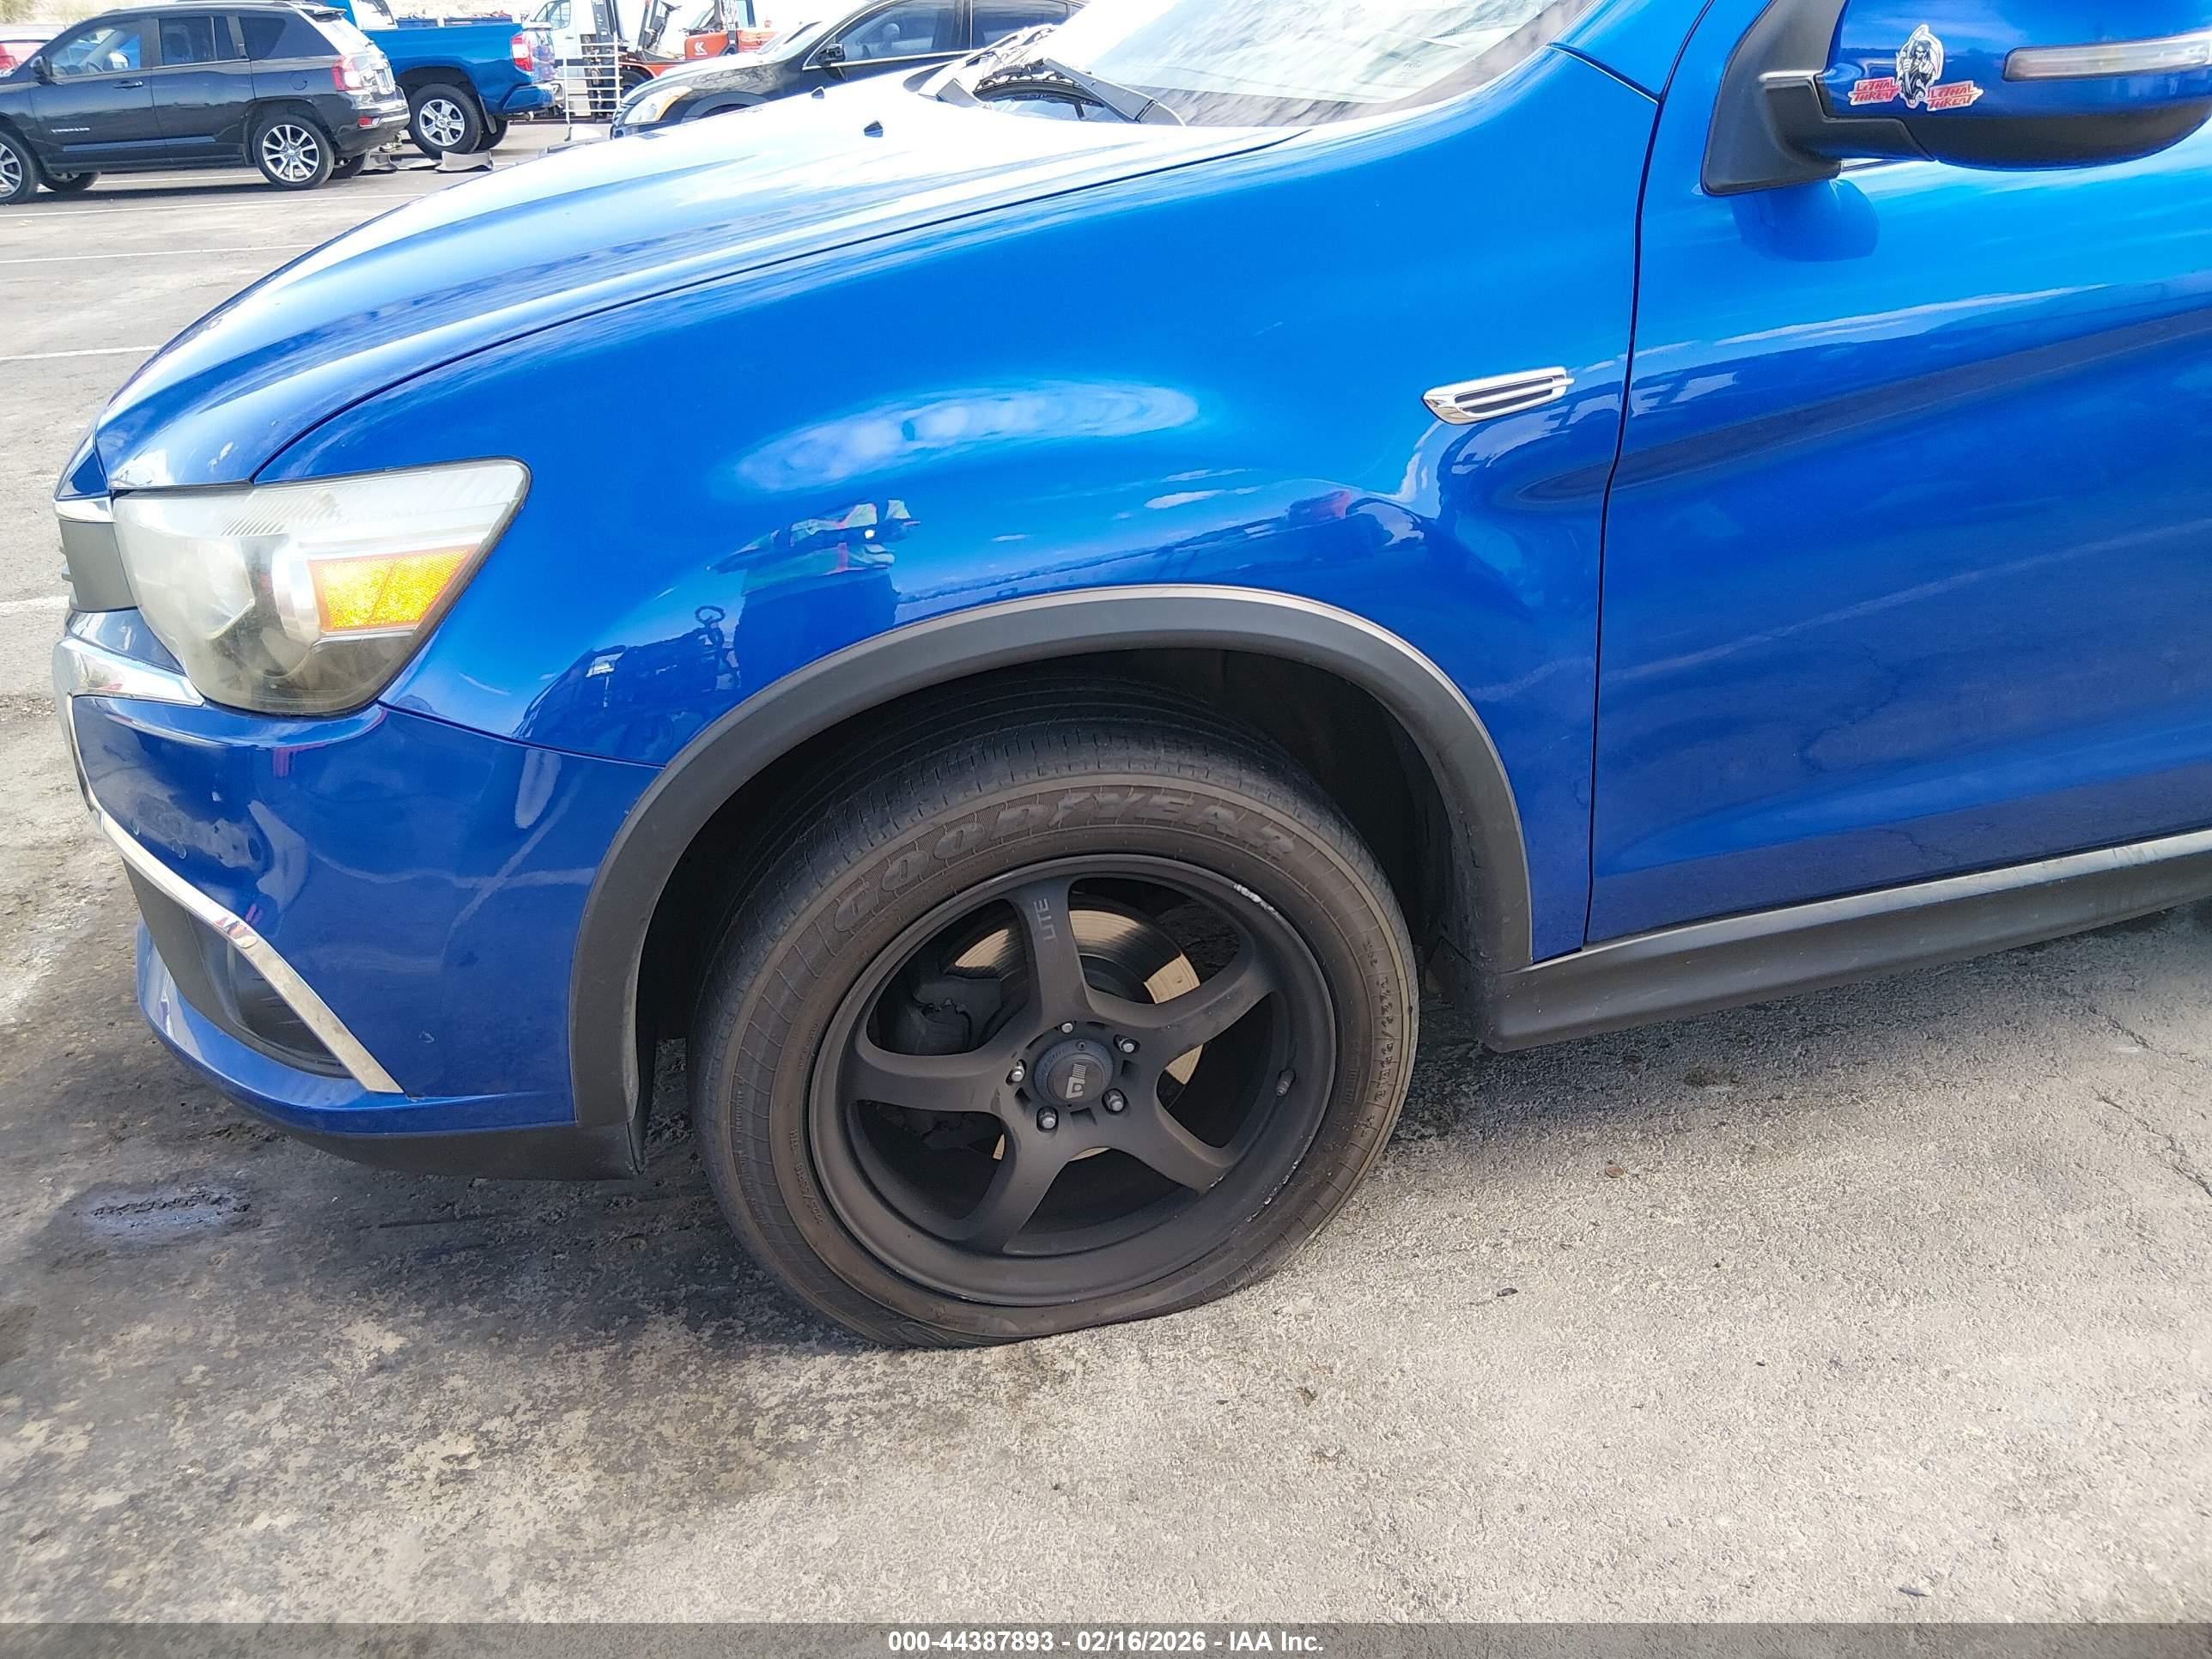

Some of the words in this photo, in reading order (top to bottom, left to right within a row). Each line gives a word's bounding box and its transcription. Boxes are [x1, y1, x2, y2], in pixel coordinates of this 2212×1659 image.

[1856, 79, 1897, 92] LETHAL
[1928, 84, 1974, 98] LETHAL
[1853, 89, 1898, 102] THREAT
[1928, 94, 1975, 109] THREAT
[833, 791, 1296, 933] GOODYEAR
[1033, 898, 1057, 941] LITE
